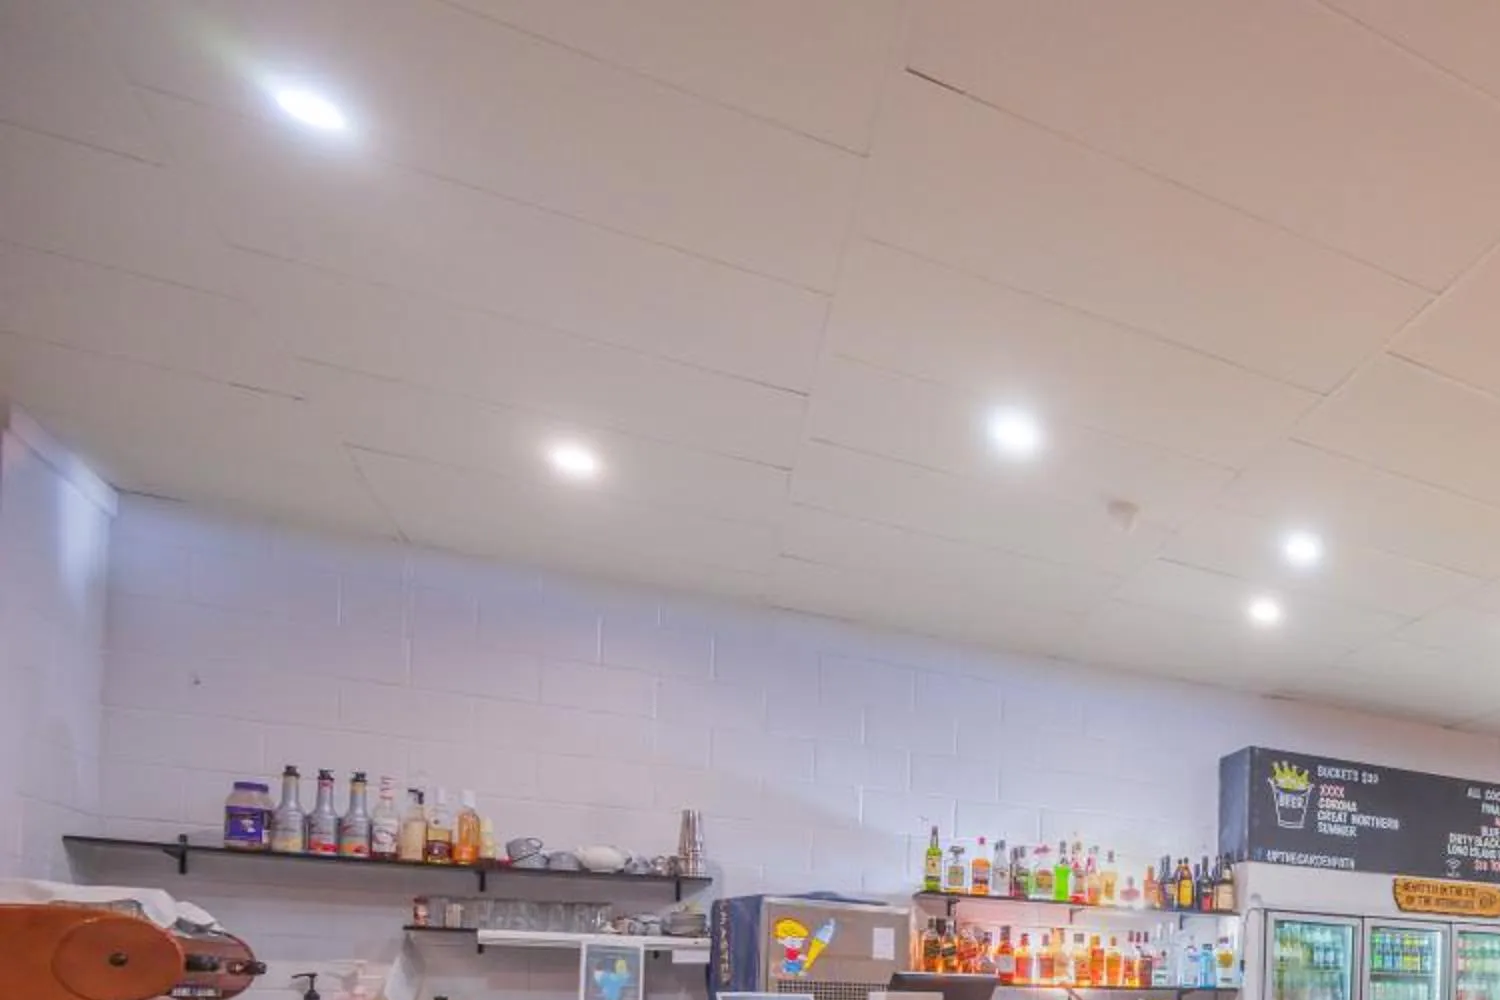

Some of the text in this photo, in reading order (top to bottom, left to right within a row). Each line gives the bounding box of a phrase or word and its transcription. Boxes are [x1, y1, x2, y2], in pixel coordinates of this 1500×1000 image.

[1317, 765, 1358, 783] BUCKETS
[1319, 784, 1345, 798] XXXX
[1279, 792, 1303, 808] BEER
[1318, 797, 1357, 812] CORONA
[1317, 810, 1399, 830] GREAT NORTHERN
[1317, 822, 1357, 837] SUMMER
